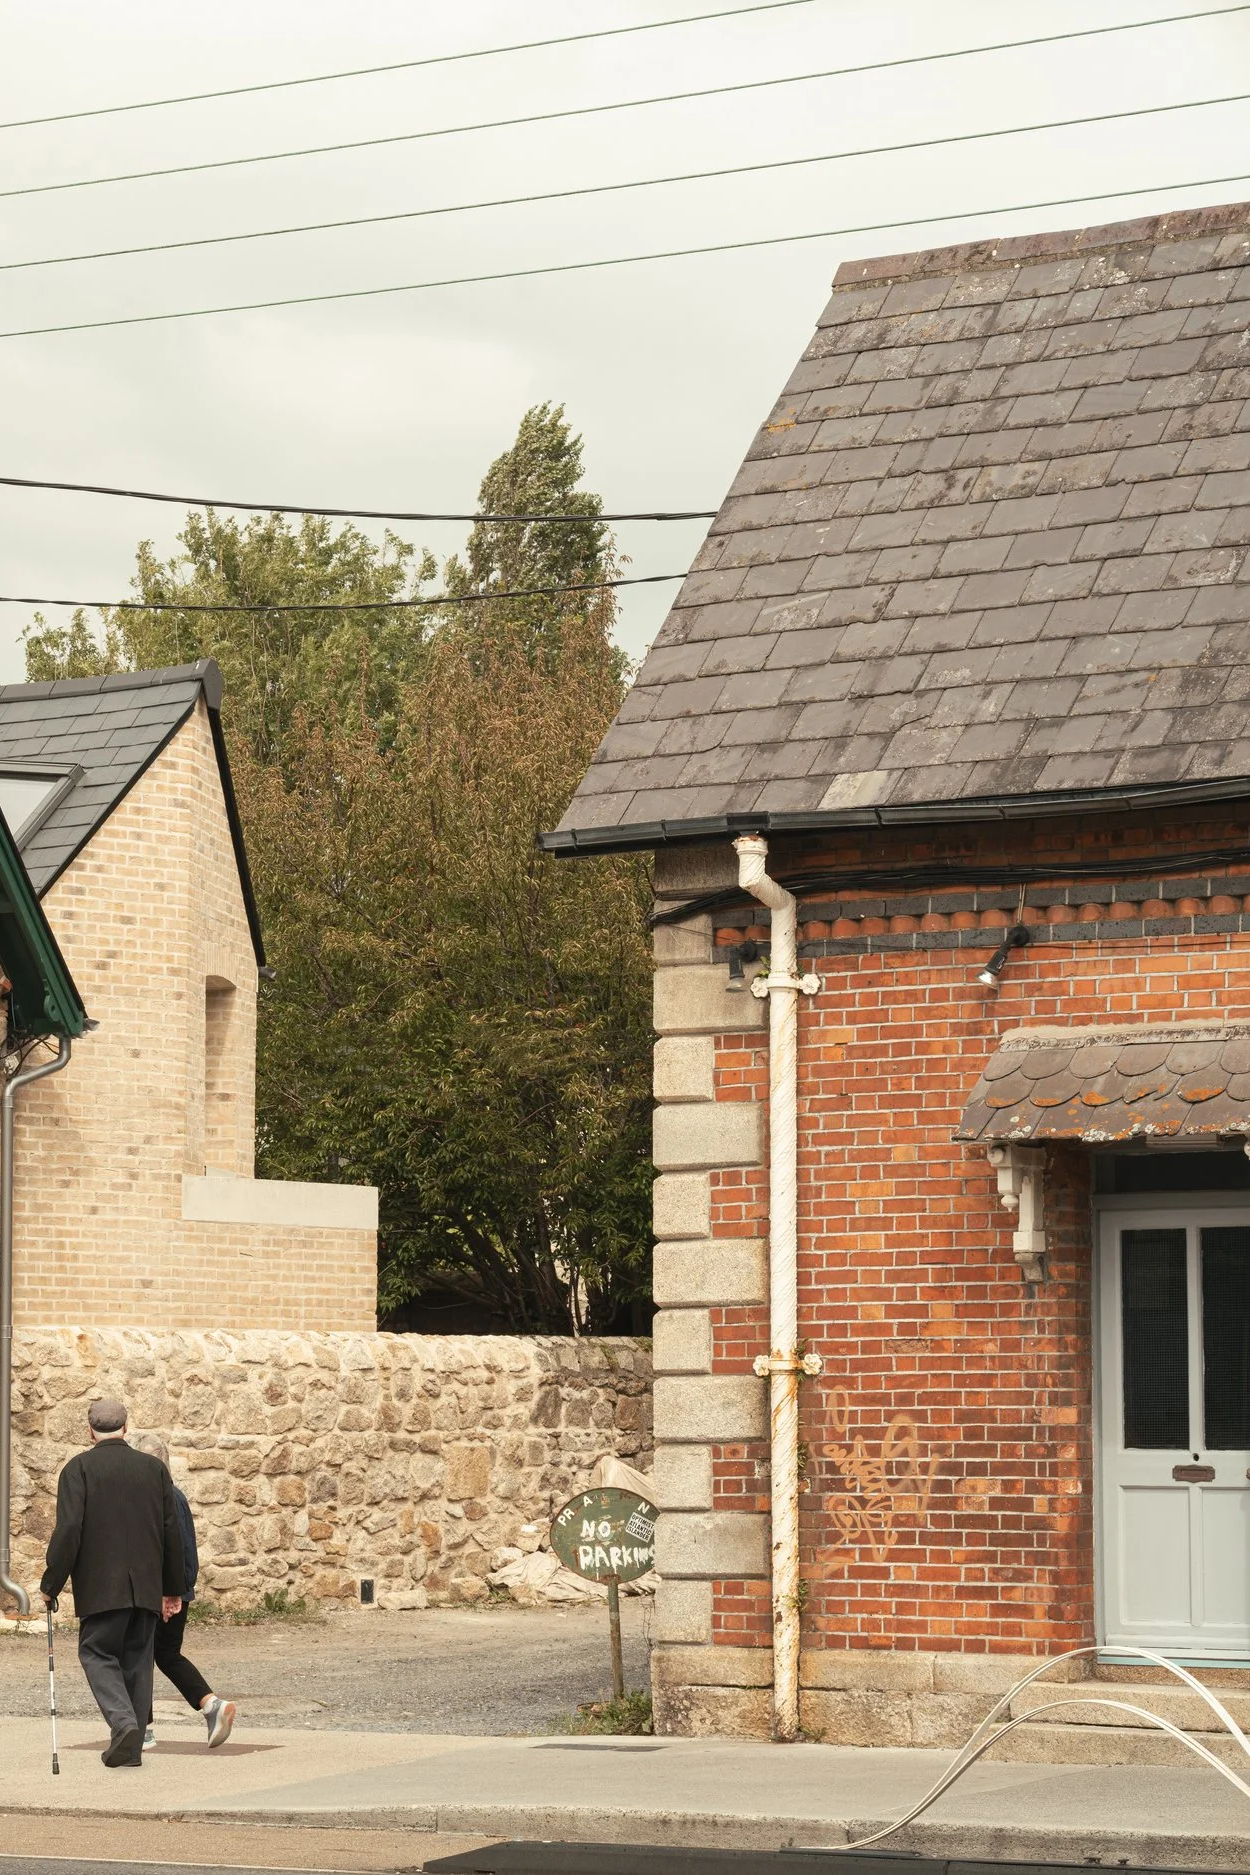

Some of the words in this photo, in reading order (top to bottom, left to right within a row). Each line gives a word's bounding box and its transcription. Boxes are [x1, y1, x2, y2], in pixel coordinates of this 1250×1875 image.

[580, 1519, 611, 1538] NO
[629, 1520, 652, 1536] ATLANTIC
[632, 1514, 655, 1529] OPTIMIST
[626, 1525, 650, 1541] ISLANDER
